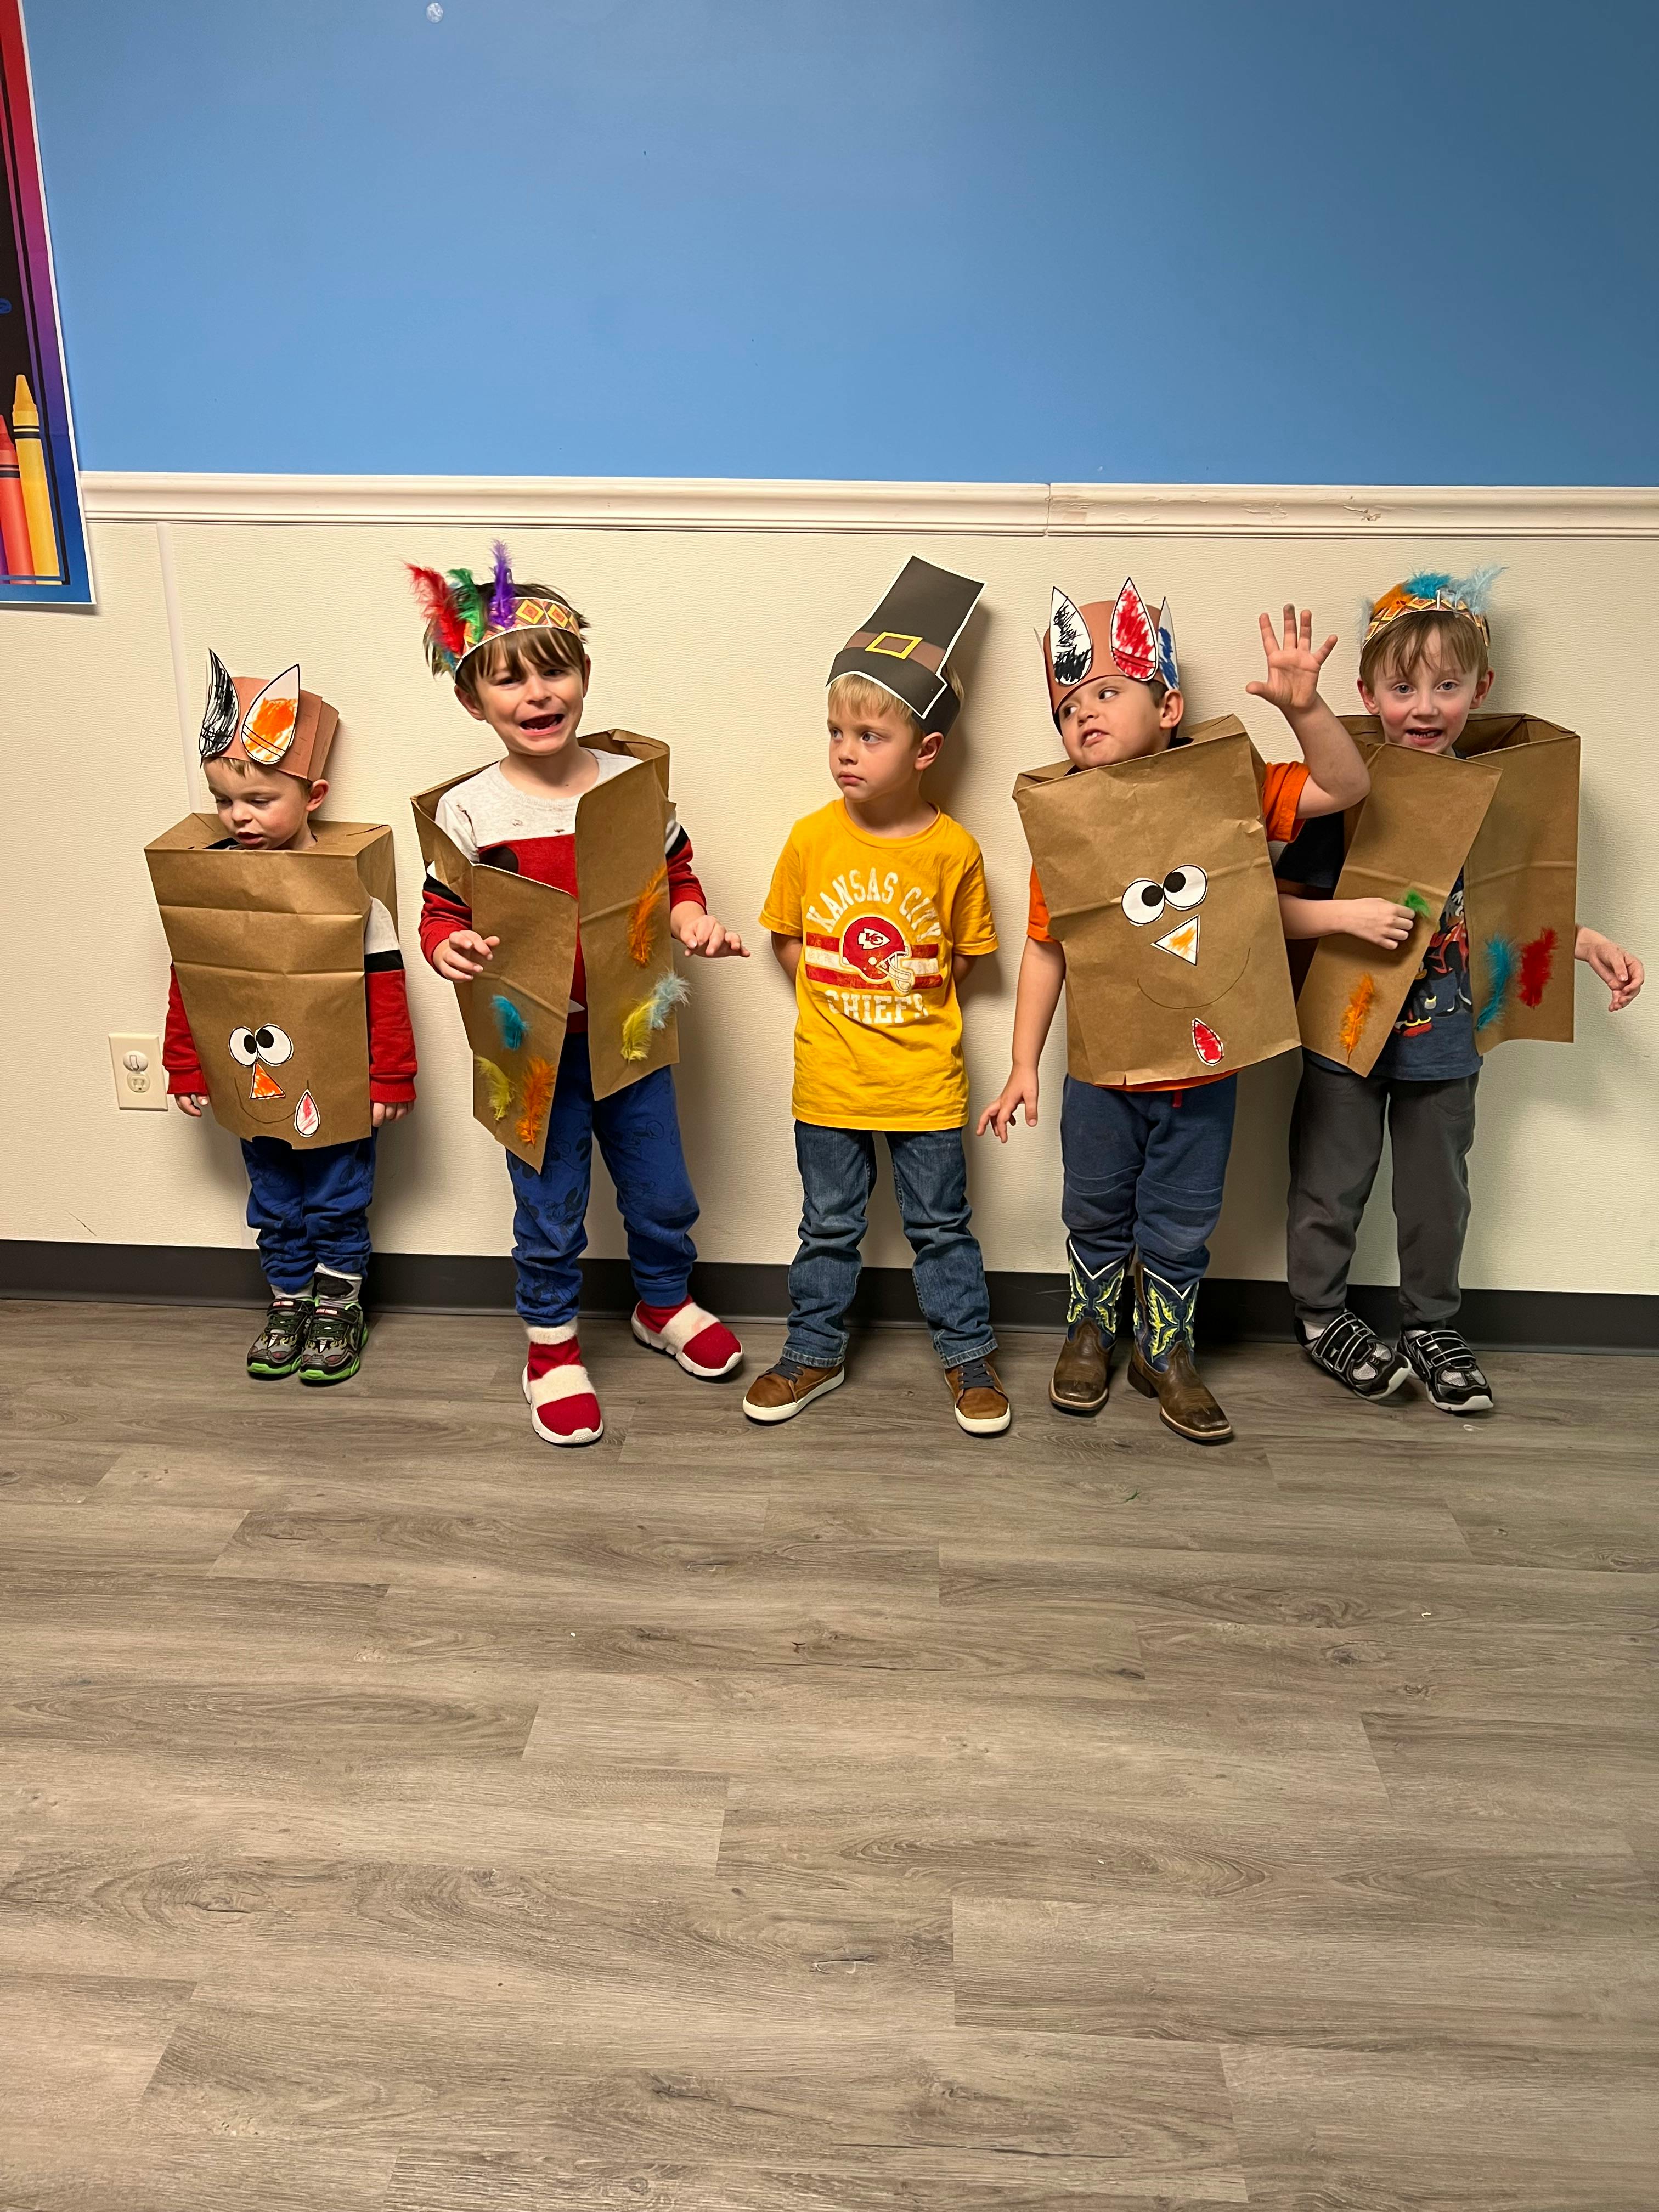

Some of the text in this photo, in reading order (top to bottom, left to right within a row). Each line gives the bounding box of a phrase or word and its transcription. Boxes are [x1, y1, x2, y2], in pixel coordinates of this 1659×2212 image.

[806, 868, 941, 942] KANSAS CITY
[865, 933, 883, 945] KC
[824, 989, 929, 1024] CHIEFS
